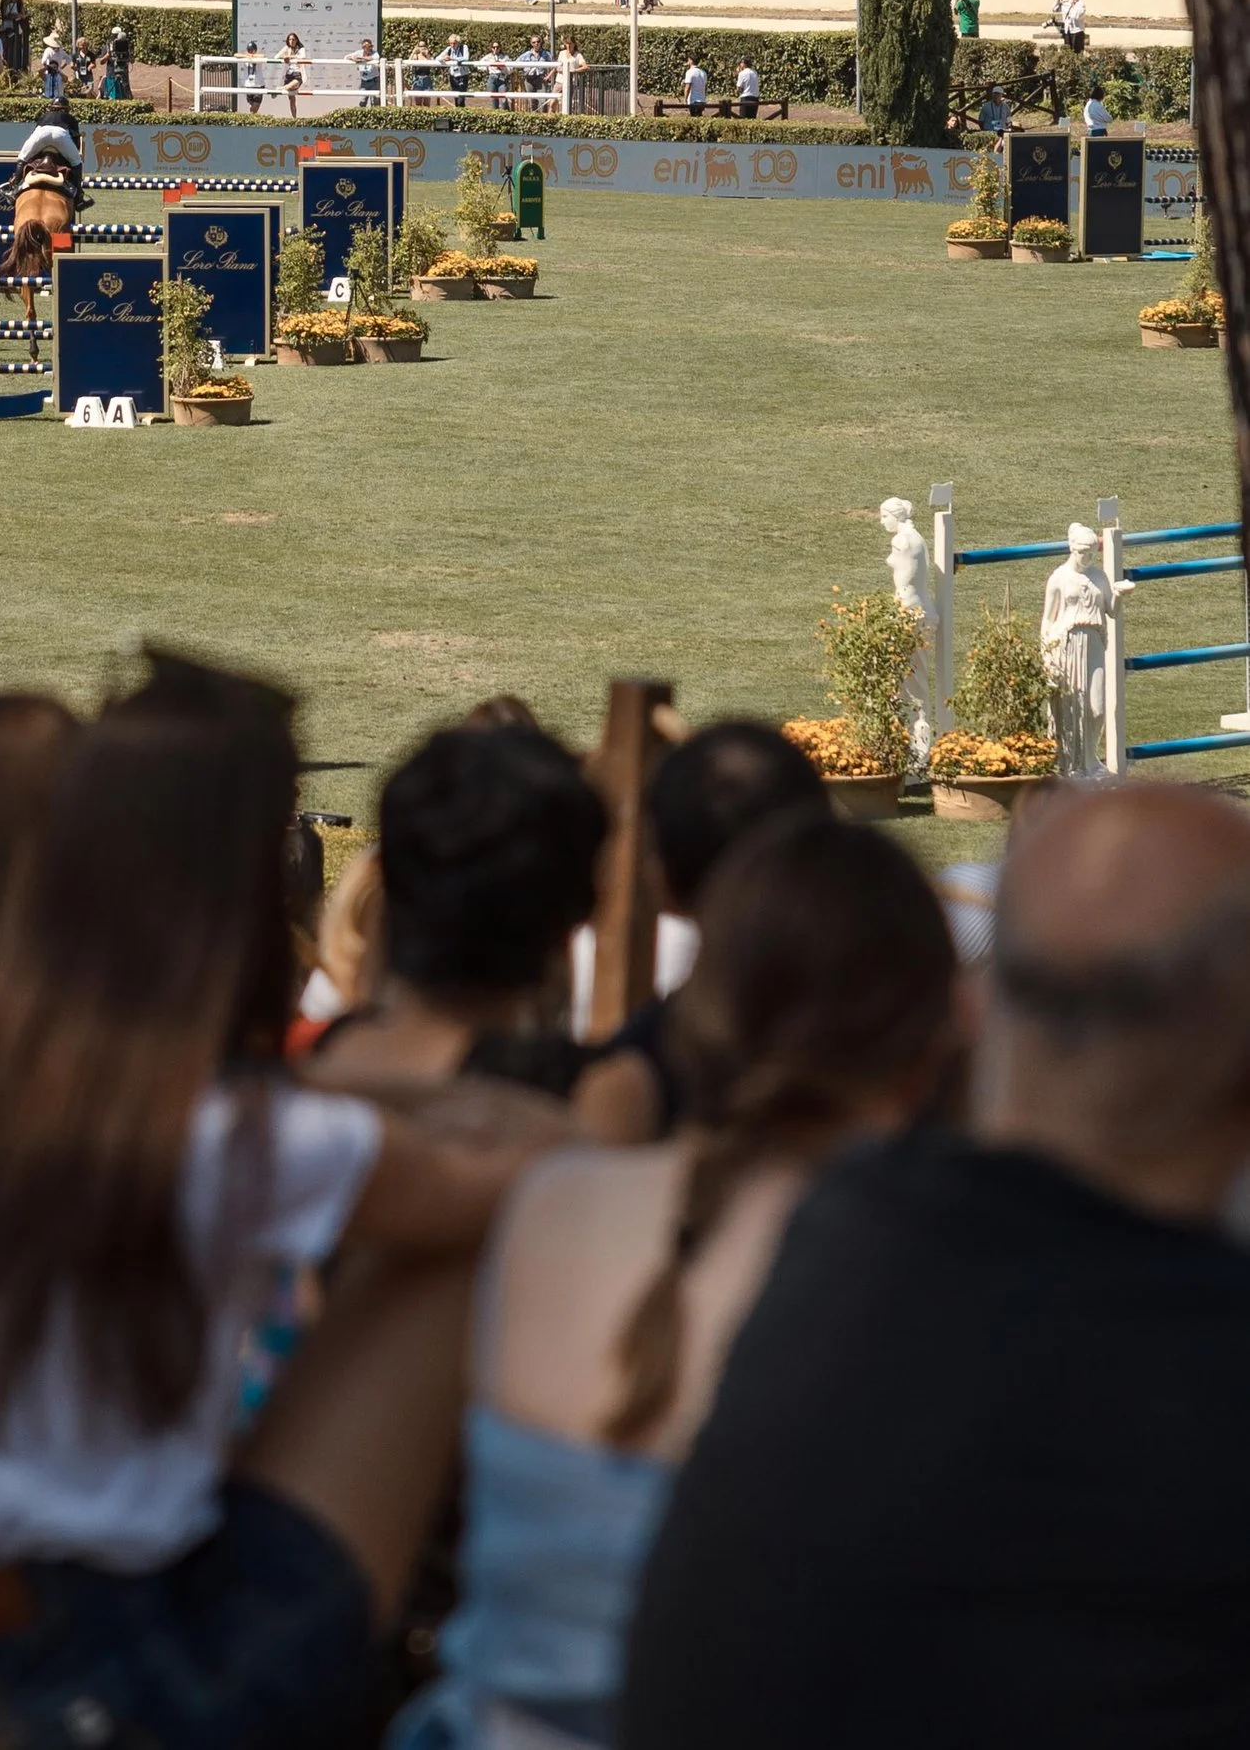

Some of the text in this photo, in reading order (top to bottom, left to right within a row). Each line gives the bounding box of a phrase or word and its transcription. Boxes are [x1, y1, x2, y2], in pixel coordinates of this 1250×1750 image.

[150, 131, 212, 163] 100
[567, 143, 619, 178] 100
[654, 149, 798, 184] eni 100
[837, 154, 990, 191] eni 10
[310, 197, 382, 218] Loro Piana
[177, 249, 259, 270] Loro Piana
[335, 282, 345, 298] C
[67, 299, 155, 323] Loro Piana
[83, 404, 91, 424] 6
[112, 404, 124, 423] A
